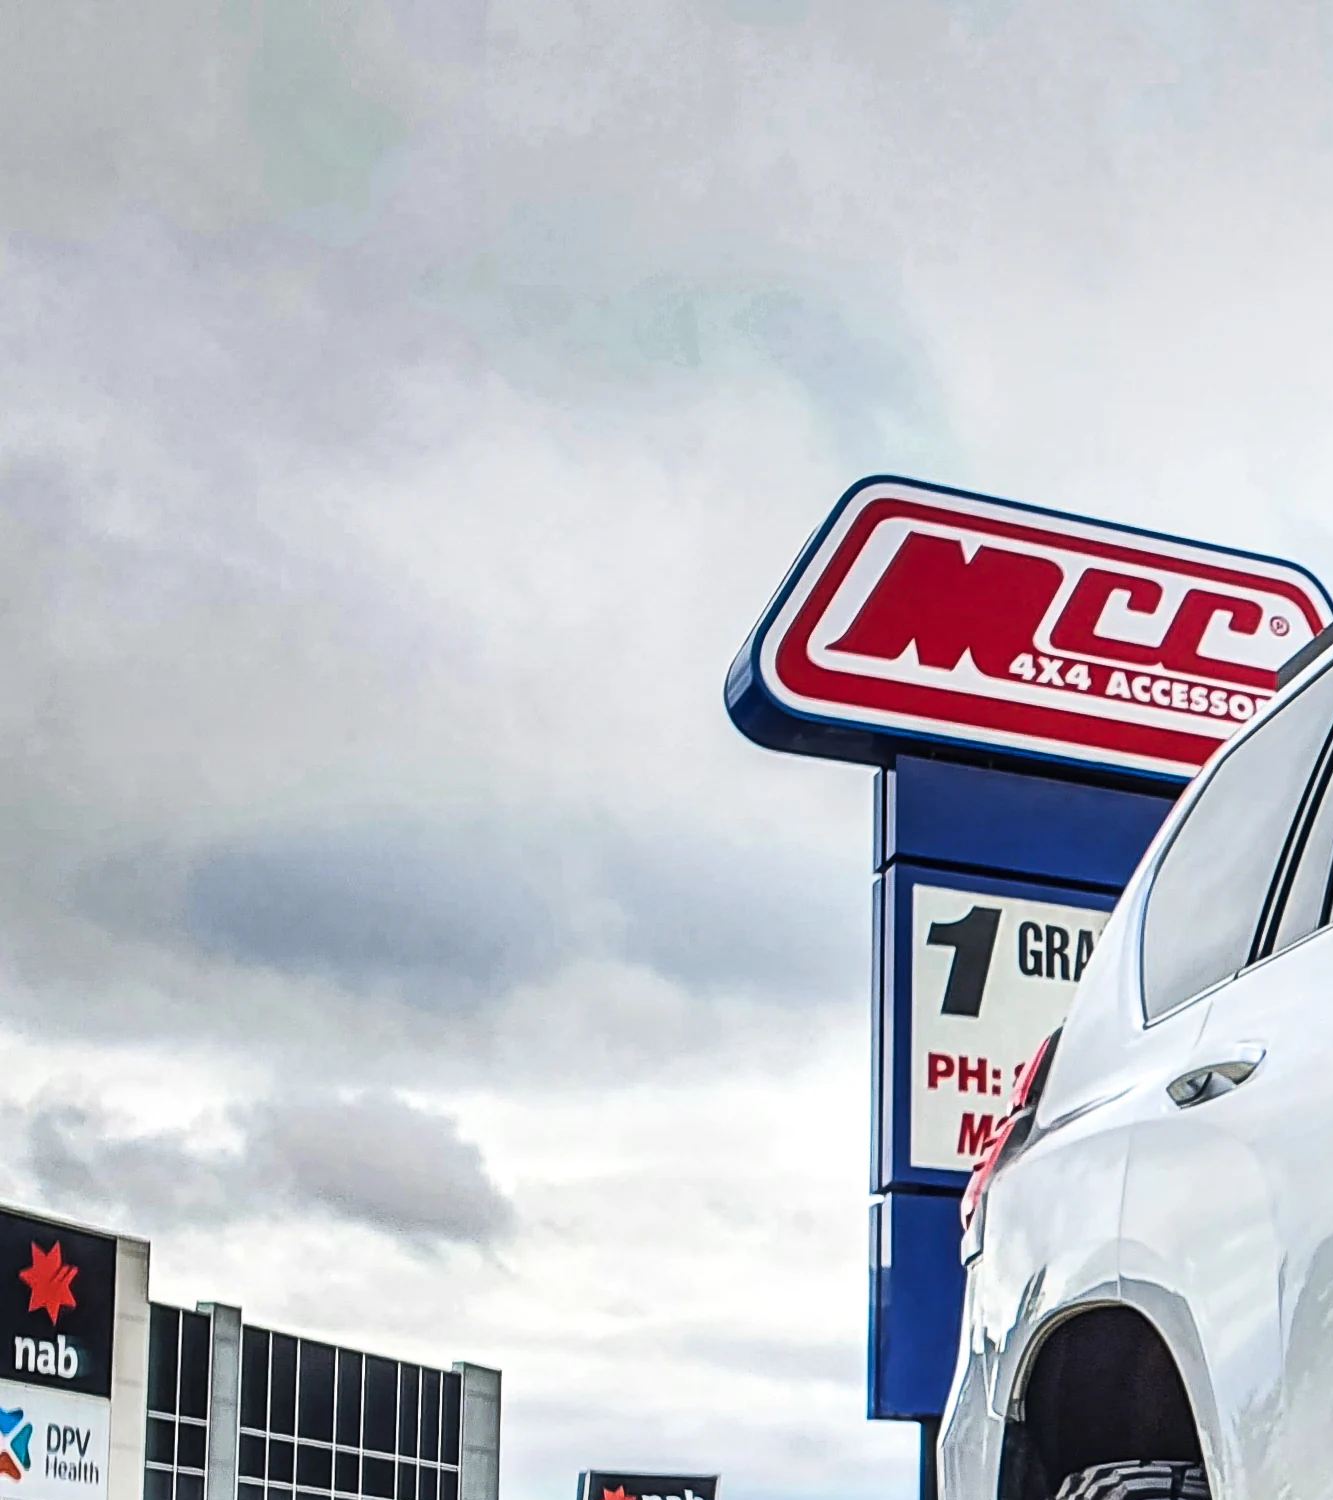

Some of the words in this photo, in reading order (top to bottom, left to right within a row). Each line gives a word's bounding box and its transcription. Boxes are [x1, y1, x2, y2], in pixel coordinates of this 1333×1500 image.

[1008, 652, 1092, 691] 4X4
[926, 905, 1003, 1018] 1
[1018, 920, 1103, 982] GRA
[927, 1051, 1002, 1096] PH:
[14, 1333, 79, 1380] nab
[46, 1422, 91, 1458] DPV
[45, 1455, 100, 1485] Health
